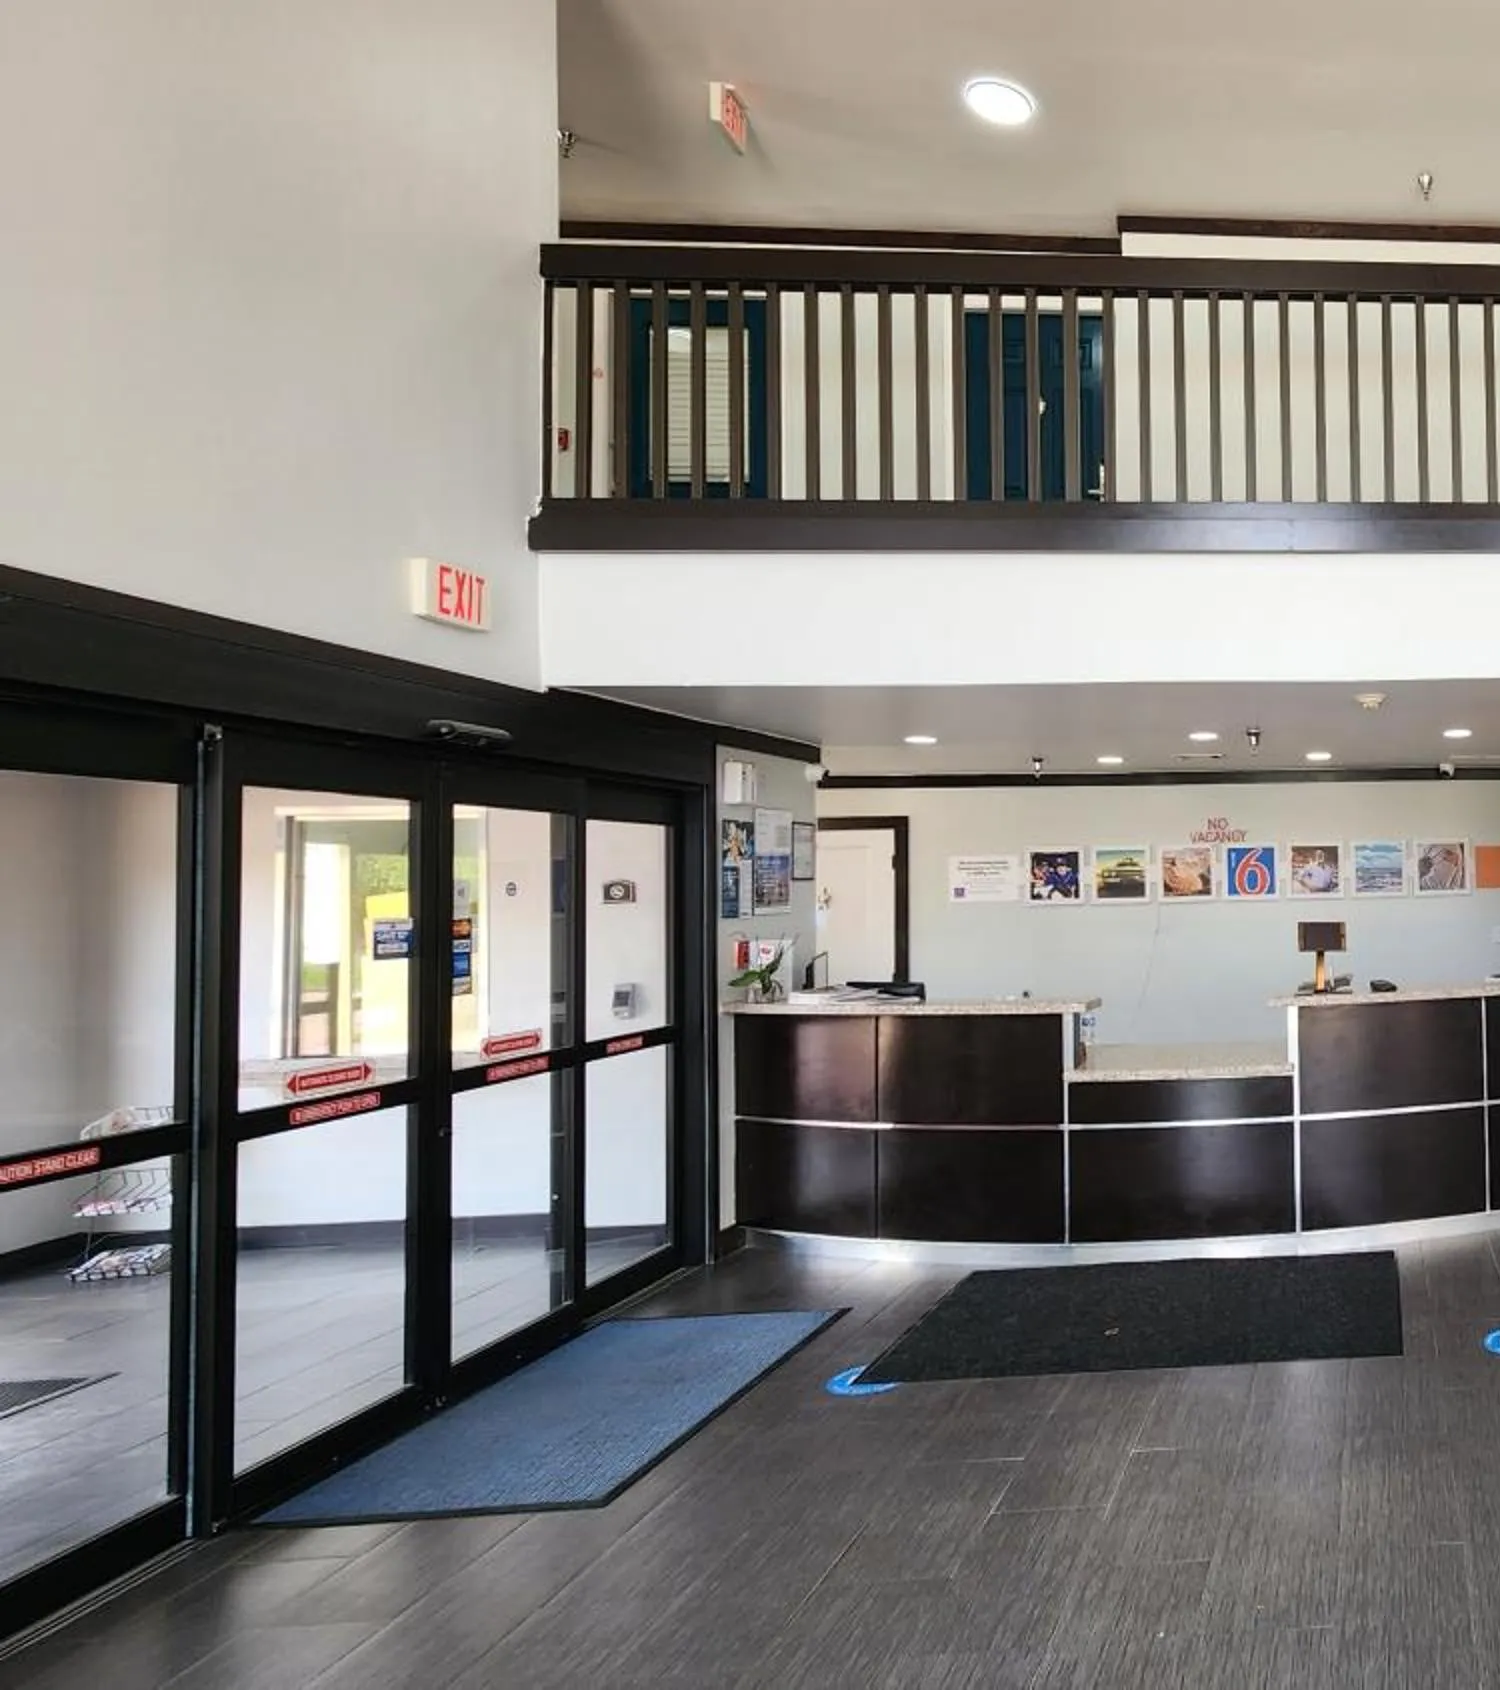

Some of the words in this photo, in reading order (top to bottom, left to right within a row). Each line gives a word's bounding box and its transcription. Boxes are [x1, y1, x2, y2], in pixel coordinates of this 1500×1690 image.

[438, 563, 485, 625] EXIT
[1190, 829, 1248, 844] VACANCY
[1207, 817, 1229, 831] NO
[1235, 848, 1271, 897] 6
